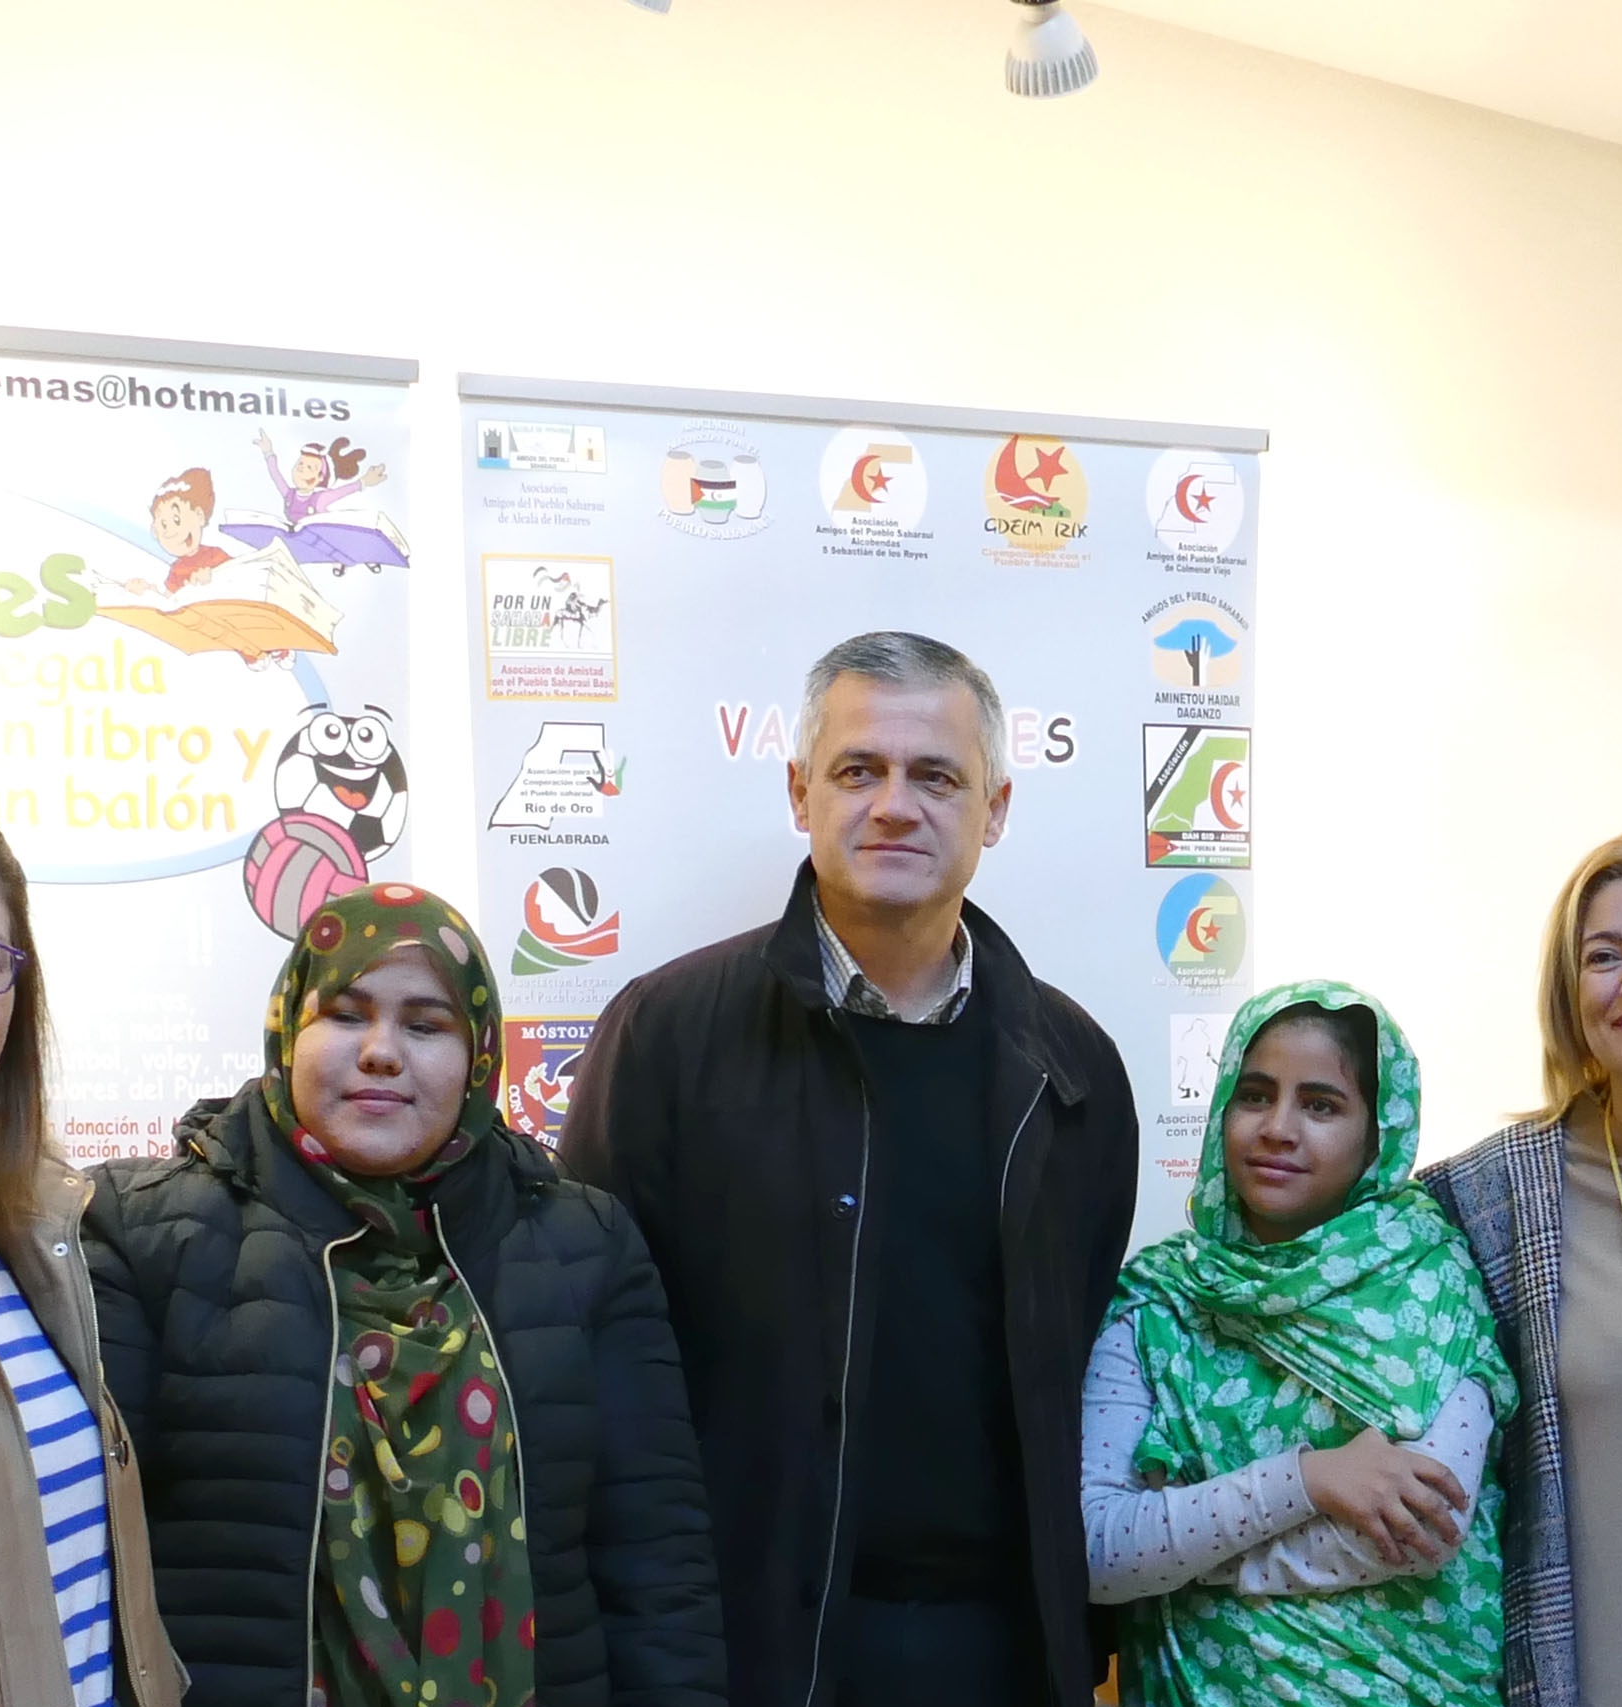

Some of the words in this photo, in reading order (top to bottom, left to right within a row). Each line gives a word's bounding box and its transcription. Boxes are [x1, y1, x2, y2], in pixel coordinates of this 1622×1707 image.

[816, 525, 847, 536] Amigos
[850, 527, 863, 536] del
[866, 528, 894, 537] Pueblo
[984, 518, 1043, 536] GDEIM
[1055, 520, 1088, 538] IZIK
[851, 537, 900, 548] Alcobendas
[876, 549, 886, 557] de
[888, 549, 901, 558] los
[903, 550, 928, 560] Reyes
[1146, 551, 1174, 563] Amigos
[1176, 553, 1188, 562] del
[1165, 563, 1174, 572] de
[493, 594, 525, 610] POR
[530, 595, 552, 610] UN
[1186, 591, 1217, 604] PUEBLO
[491, 627, 552, 647] LIBRE
[554, 665, 565, 675] de
[567, 666, 604, 676] Amistad
[518, 677, 548, 687] Pueblo
[1154, 691, 1205, 704] AMINETOU
[1207, 694, 1241, 706] HAIDAR
[1177, 706, 1222, 719] DAGANZO
[64, 704, 212, 764] libro
[232, 727, 272, 782] y
[1157, 739, 1190, 786] Asociación
[64, 771, 236, 833] balón
[550, 802, 567, 813] de
[570, 803, 594, 813] Oro
[509, 834, 610, 845] FUENLABRADA
[521, 1024, 594, 1040] MÓSTOL
[508, 1084, 525, 1114] CON
[65, 1115, 138, 1136] donación
[147, 1115, 162, 1136] al
[517, 1115, 535, 1135] EL
[1156, 1113, 1209, 1125] Asociaci
[1165, 1127, 1188, 1137] con
[1191, 1127, 1203, 1137] el
[65, 1138, 121, 1159] ciación
[129, 1145, 139, 1158] o
